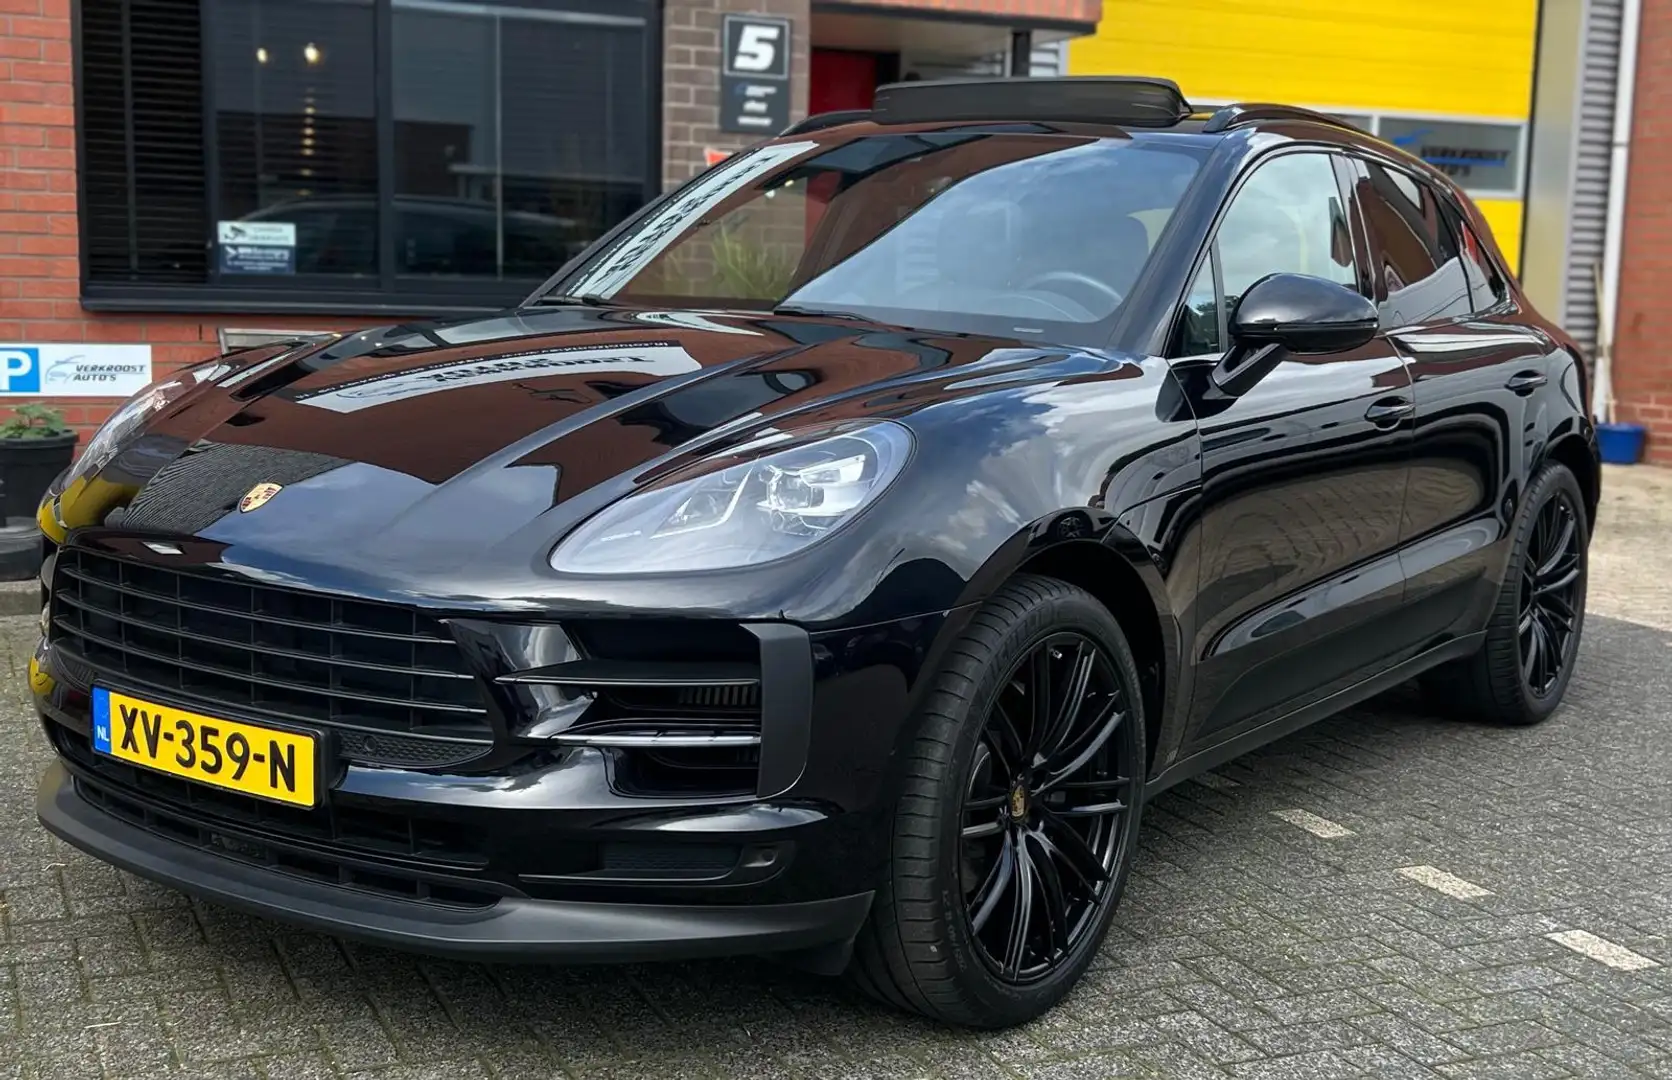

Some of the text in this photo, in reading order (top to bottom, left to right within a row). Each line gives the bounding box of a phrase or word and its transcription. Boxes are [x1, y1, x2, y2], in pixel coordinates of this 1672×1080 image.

[733, 24, 779, 71] 5
[0, 351, 31, 391] P
[73, 374, 116, 382] AUTO'S
[76, 364, 146, 373] VERKROOST
[97, 724, 110, 742] NL
[119, 704, 296, 792] XV-359-N
